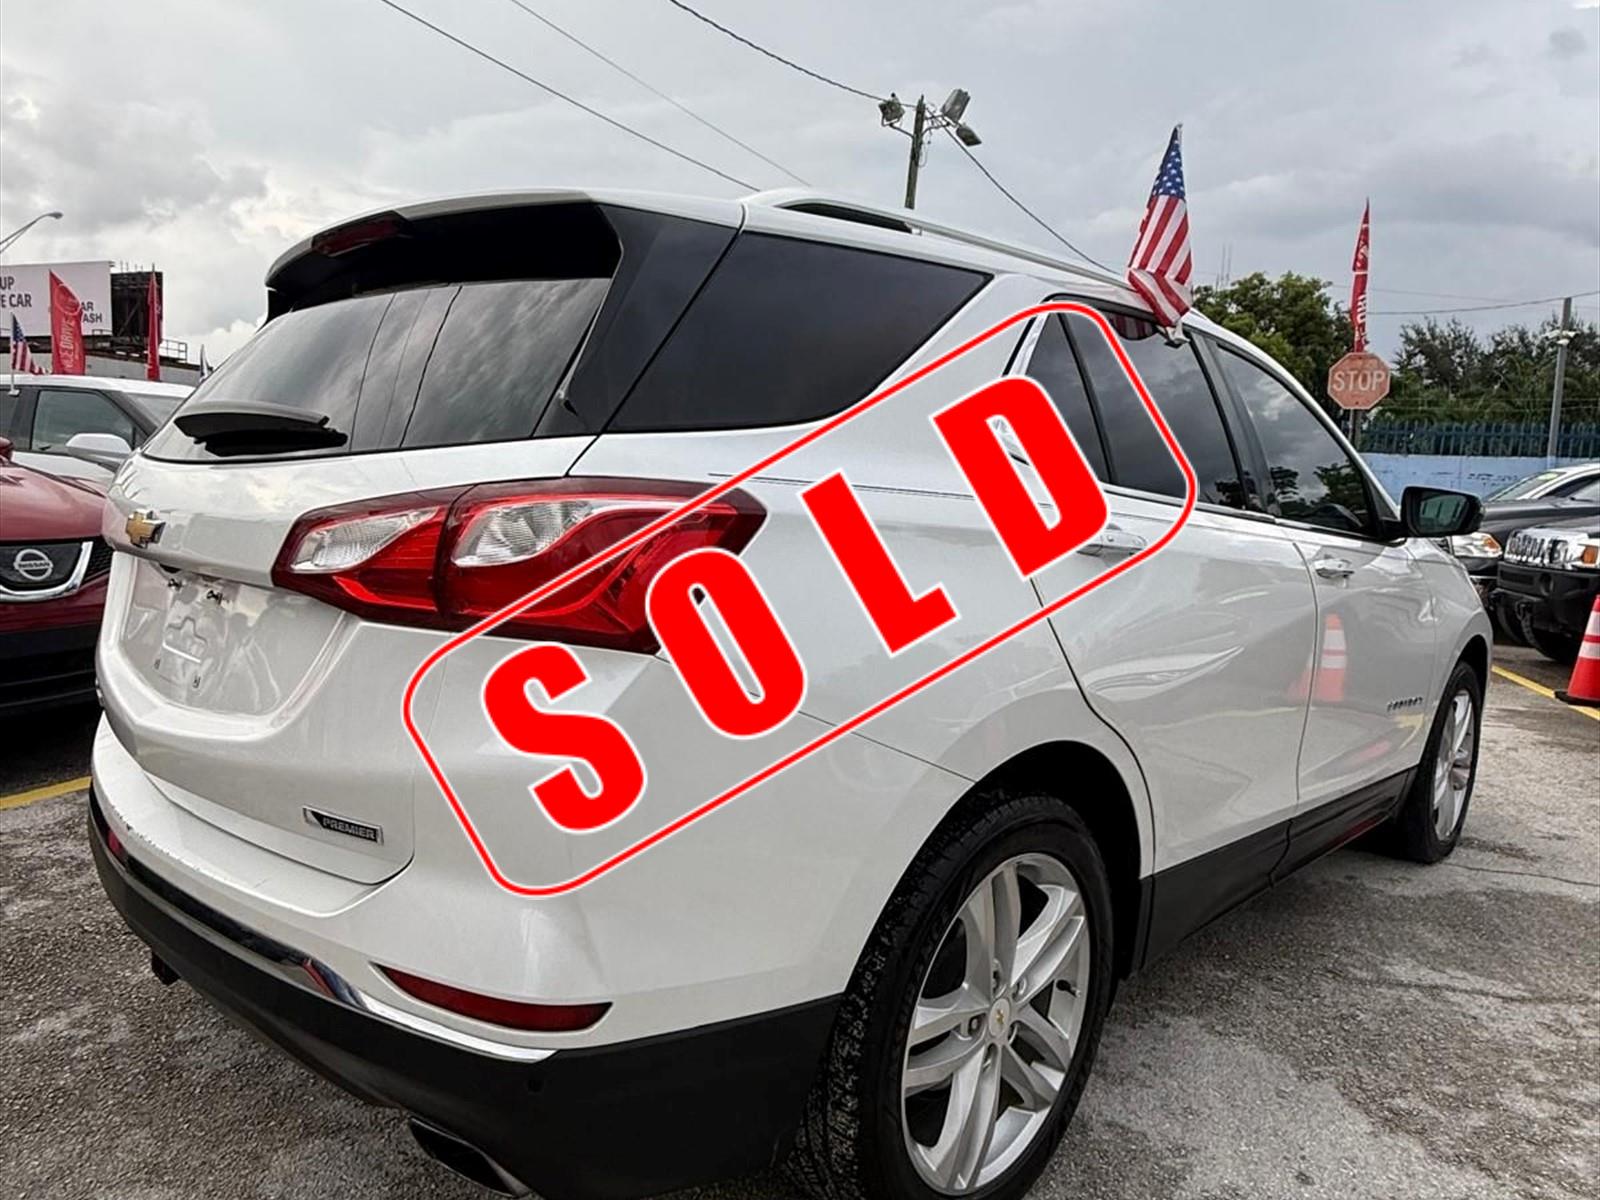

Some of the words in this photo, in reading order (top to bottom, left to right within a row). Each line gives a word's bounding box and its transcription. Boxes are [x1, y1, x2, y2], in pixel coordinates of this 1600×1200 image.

[9, 293, 32, 308] CAR
[81, 301, 94, 311] AR
[82, 312, 103, 324] ASH
[1332, 369, 1386, 392] STOP
[322, 817, 376, 839] PREMIER
